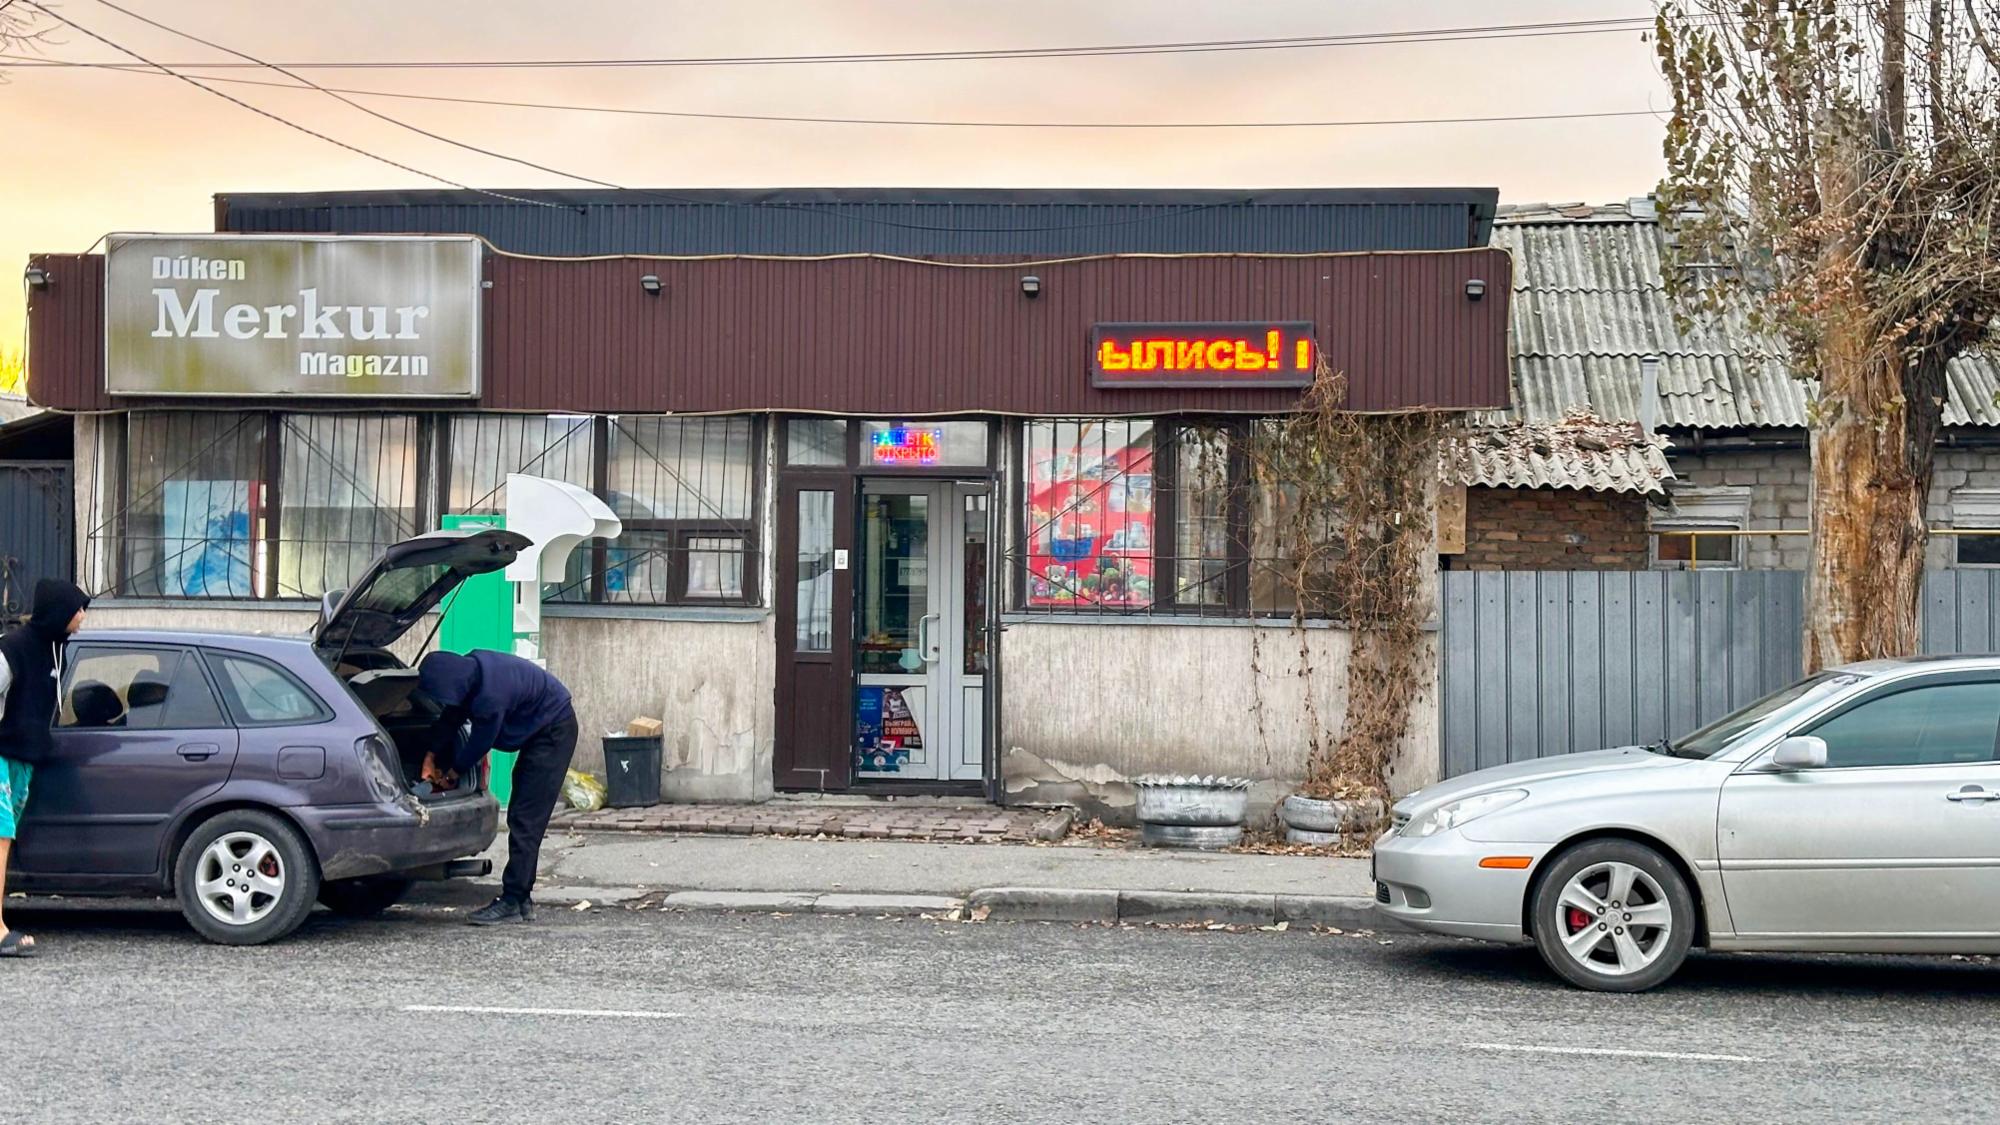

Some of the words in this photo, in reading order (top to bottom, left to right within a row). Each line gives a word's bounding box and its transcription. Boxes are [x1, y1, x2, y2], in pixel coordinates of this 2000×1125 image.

[152, 254, 246, 281] Dúken
[151, 287, 429, 341] Merkur
[1098, 330, 1280, 370] ылись!
[876, 446, 937, 460] ОТКРЫТО
